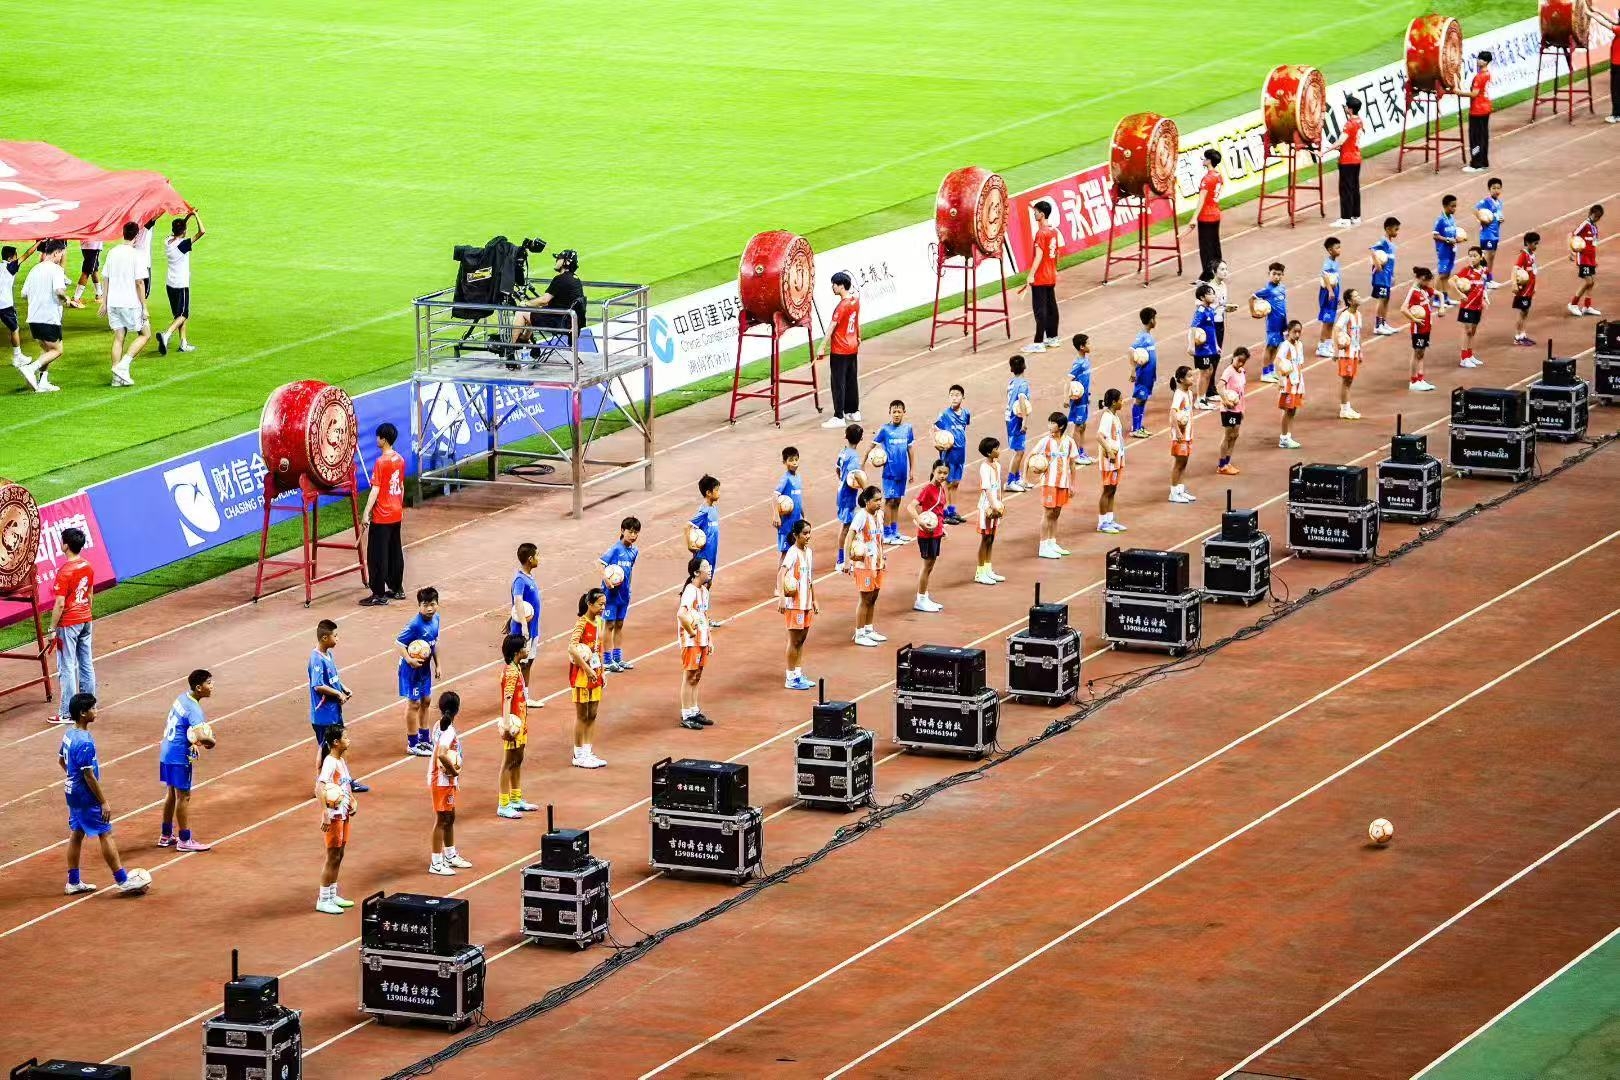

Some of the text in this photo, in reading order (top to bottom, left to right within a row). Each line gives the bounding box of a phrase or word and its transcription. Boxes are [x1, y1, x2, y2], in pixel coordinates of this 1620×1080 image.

[1463, 448, 1482, 458] Spark
[224, 498, 258, 520] CHASING
[412, 688, 420, 697] 16
[910, 716, 963, 731] 吉阳舞台特效
[915, 727, 958, 738] 13908461940
[668, 837, 725, 854] 吉阳舞台特效
[674, 850, 719, 861] 13908461940
[380, 980, 441, 998] 吉阳舞台特效
[386, 993, 435, 1006] 13908461940
